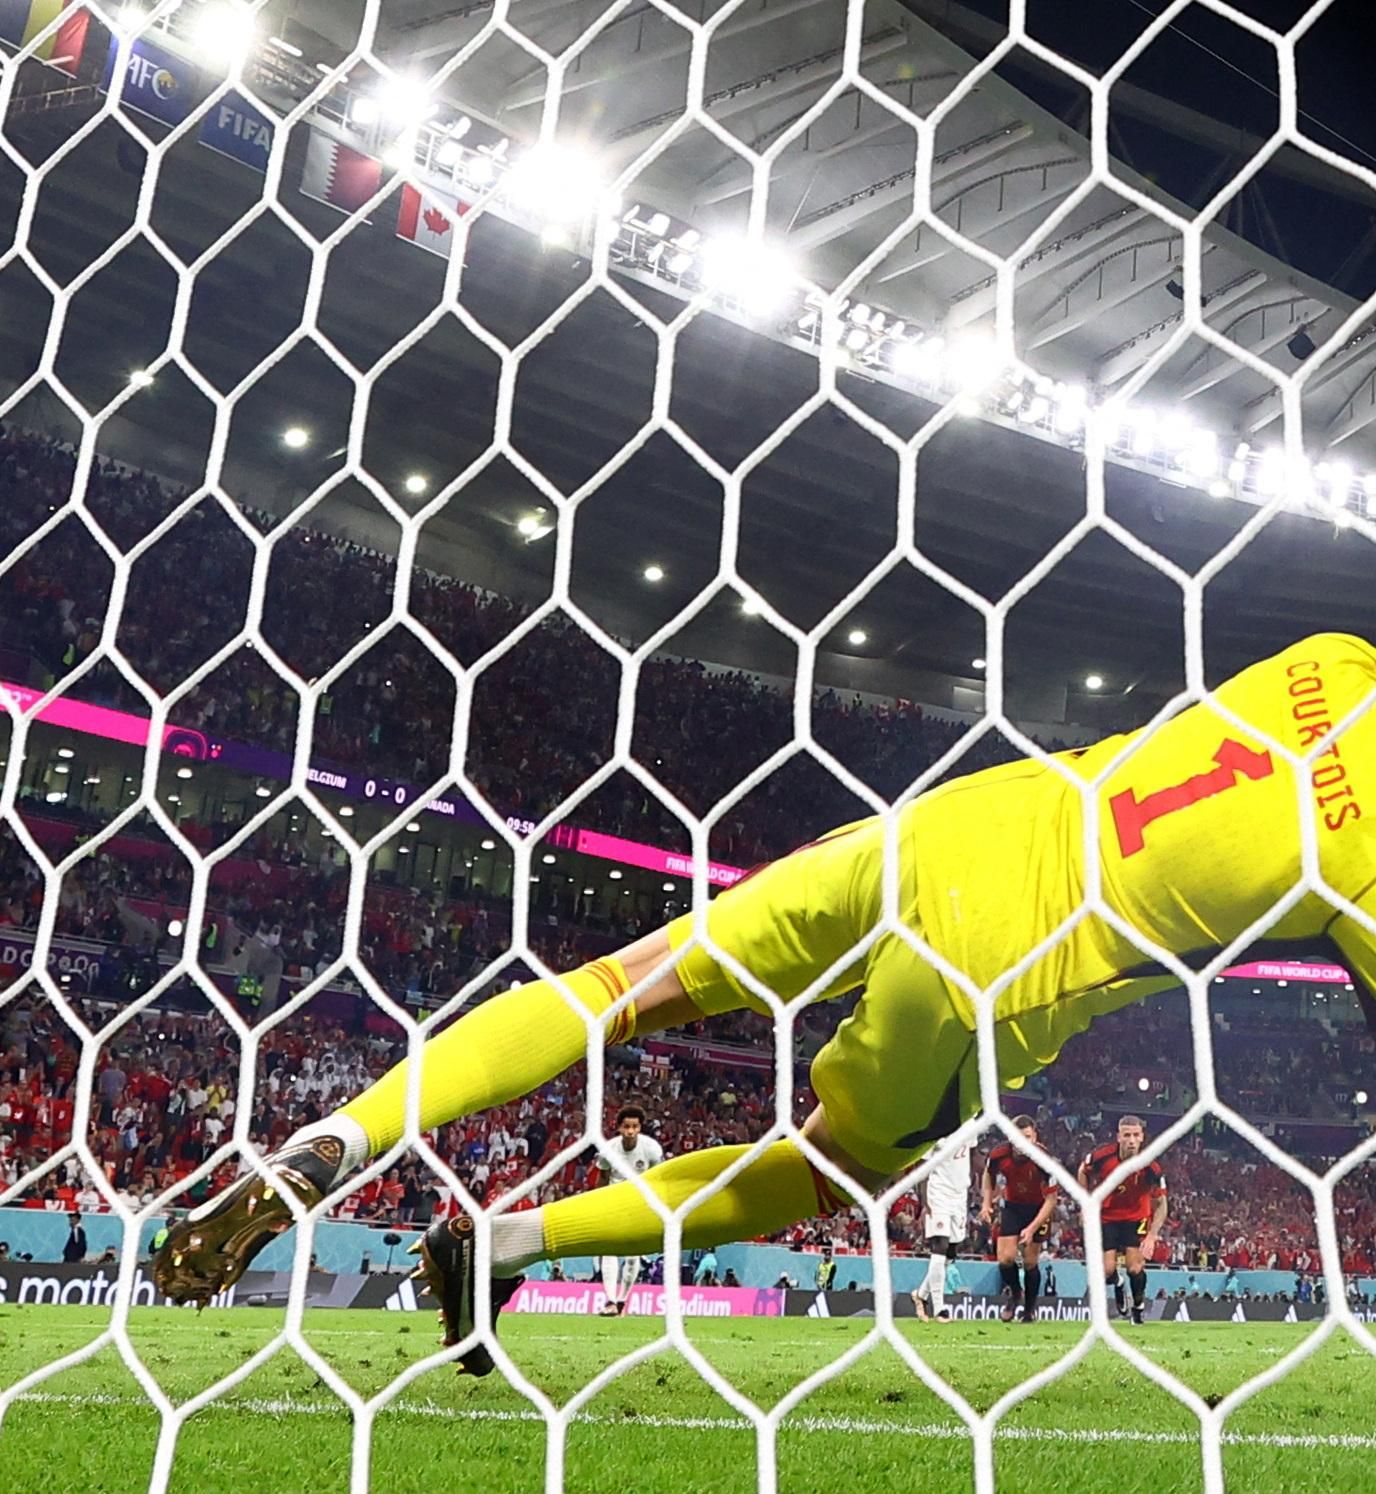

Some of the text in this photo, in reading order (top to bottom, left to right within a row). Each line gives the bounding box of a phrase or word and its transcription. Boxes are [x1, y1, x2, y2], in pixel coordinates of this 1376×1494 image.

[217, 105, 271, 151] FIFA
[1286, 661, 1361, 831] COURTOIS
[308, 769, 347, 789] ELGIUM
[365, 780, 376, 797] 0
[395, 787, 406, 804] 0
[506, 817, 535, 834] 09:58
[1109, 738, 1274, 858] 1
[1257, 965, 1343, 979] FIFA WORLD CUP
[1137, 1217, 1147, 1234] 2
[515, 1289, 590, 1315] Ahmad
[627, 1292, 653, 1316] Ali
